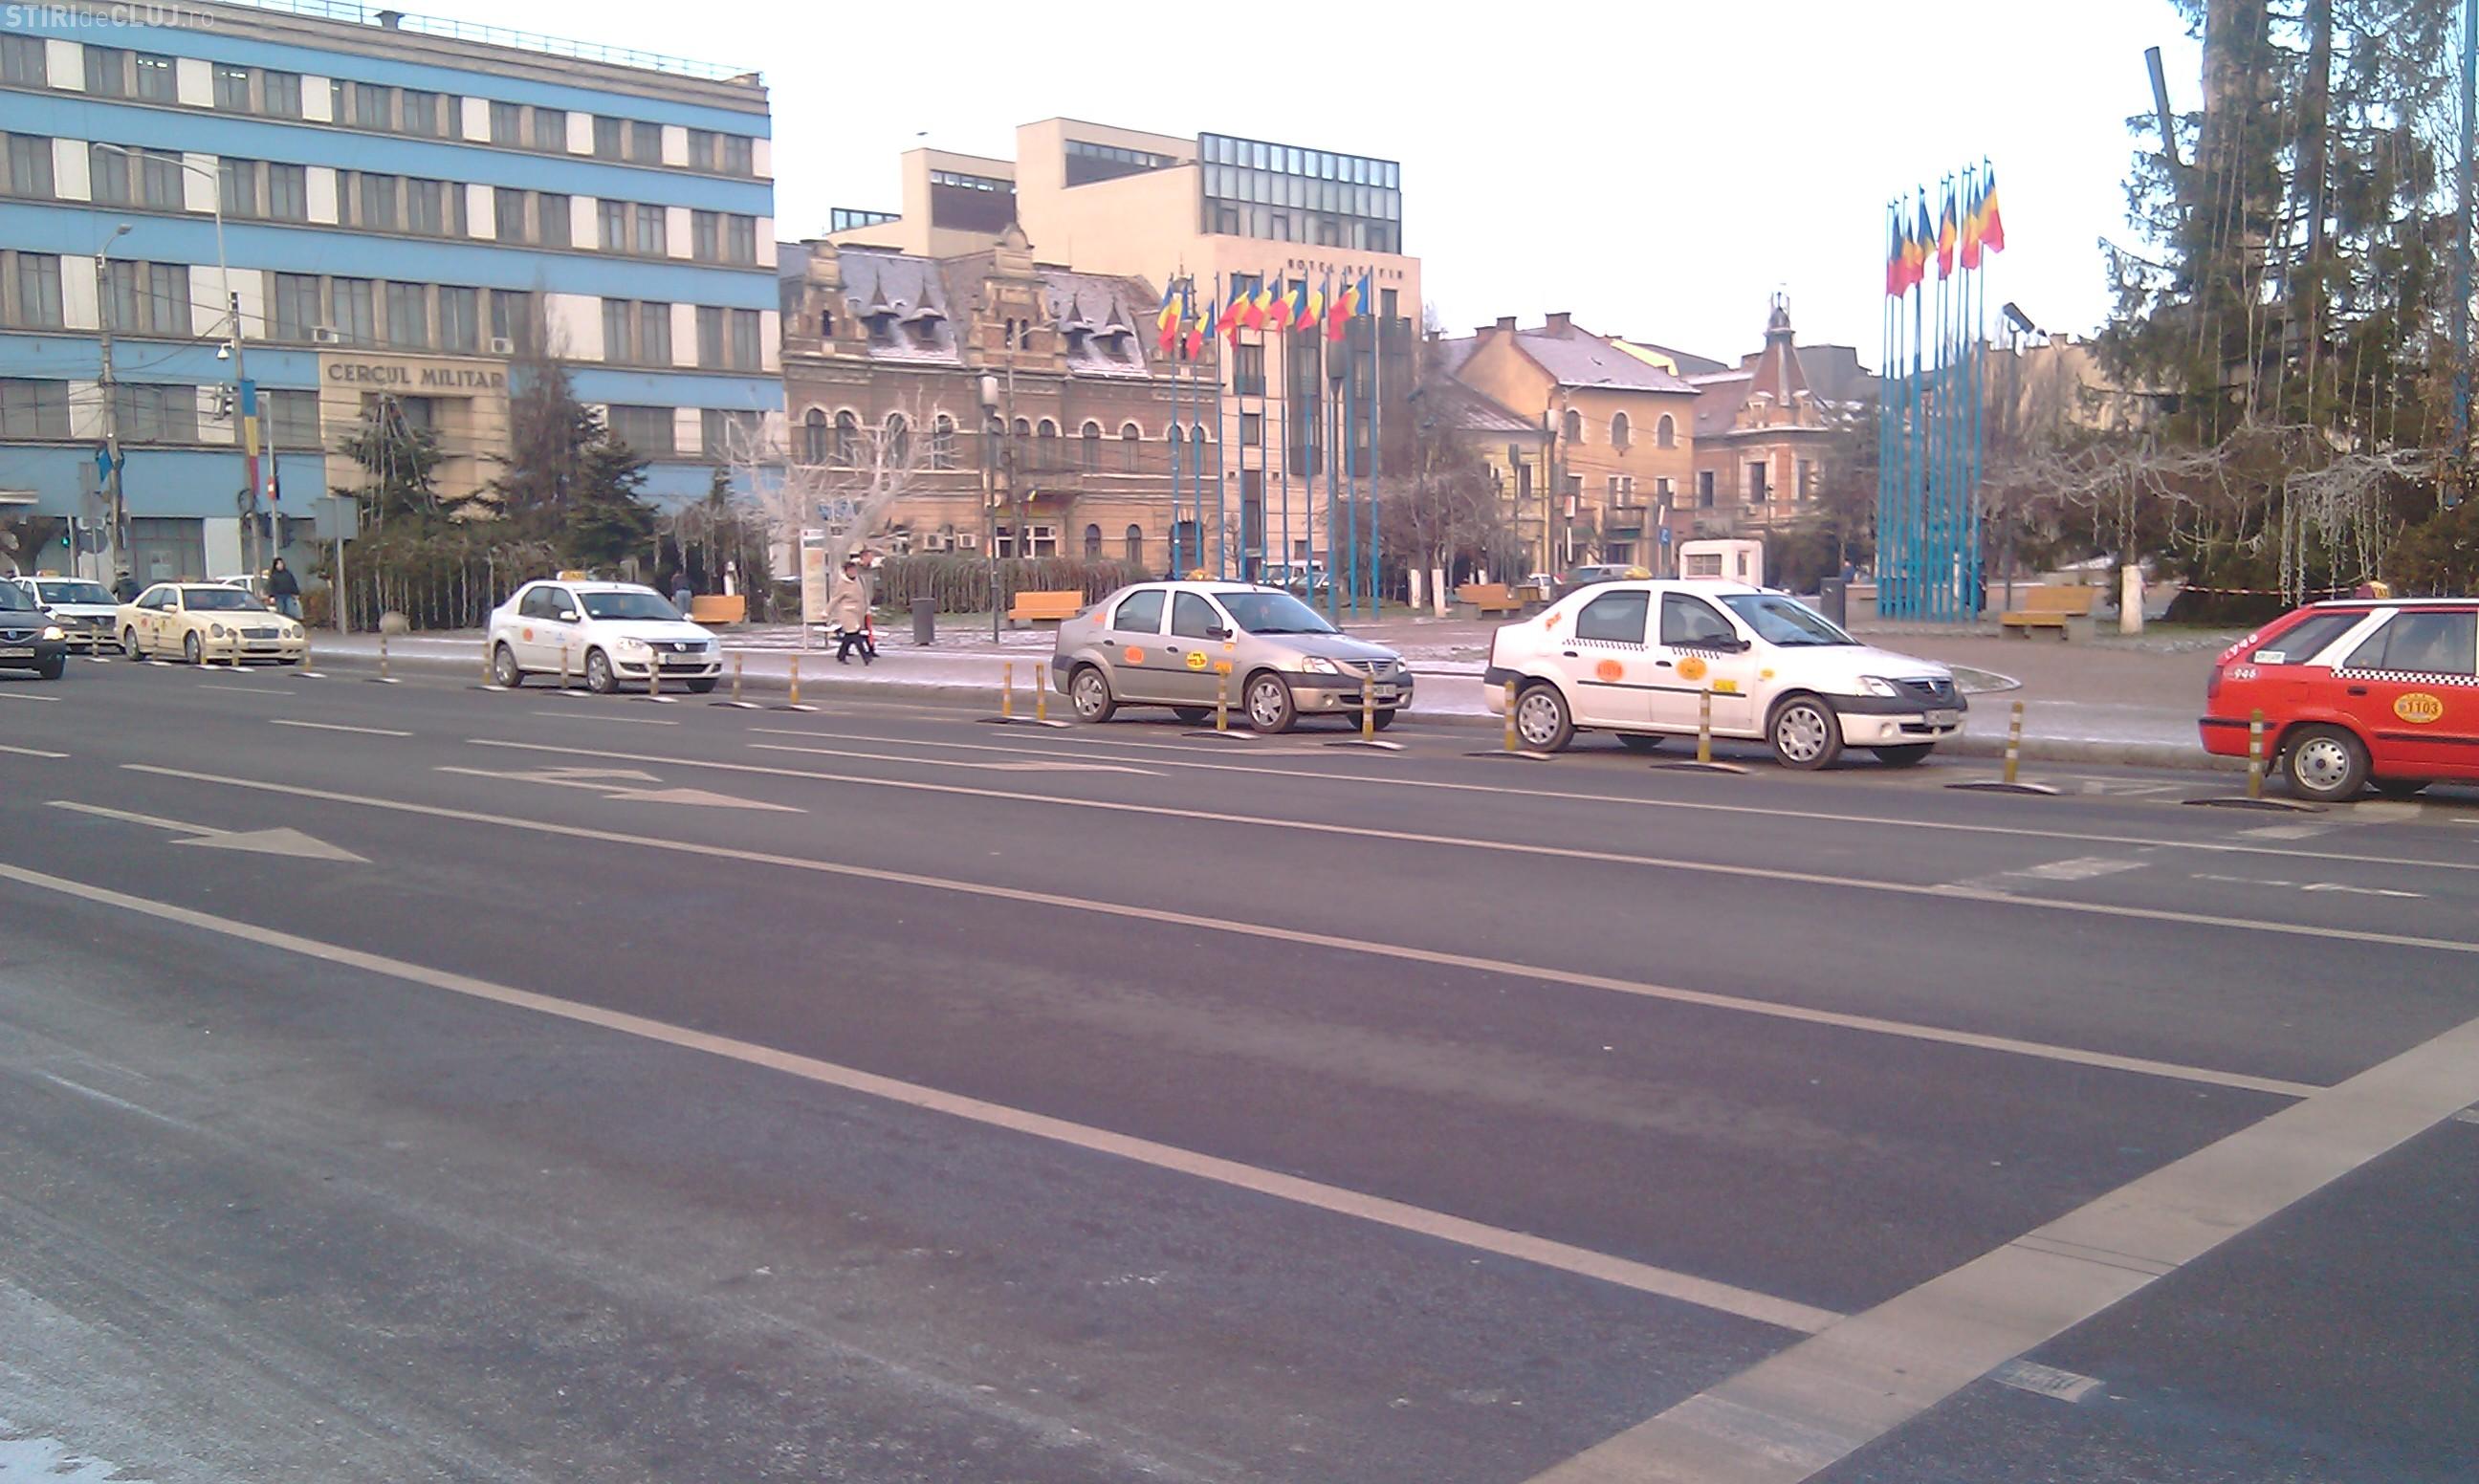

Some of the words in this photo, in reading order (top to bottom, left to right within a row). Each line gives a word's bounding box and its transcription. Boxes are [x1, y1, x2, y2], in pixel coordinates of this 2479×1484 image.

[327, 363, 411, 384] CERCUL
[420, 367, 504, 388] MILITAR
[2407, 700, 2440, 715] 1103
